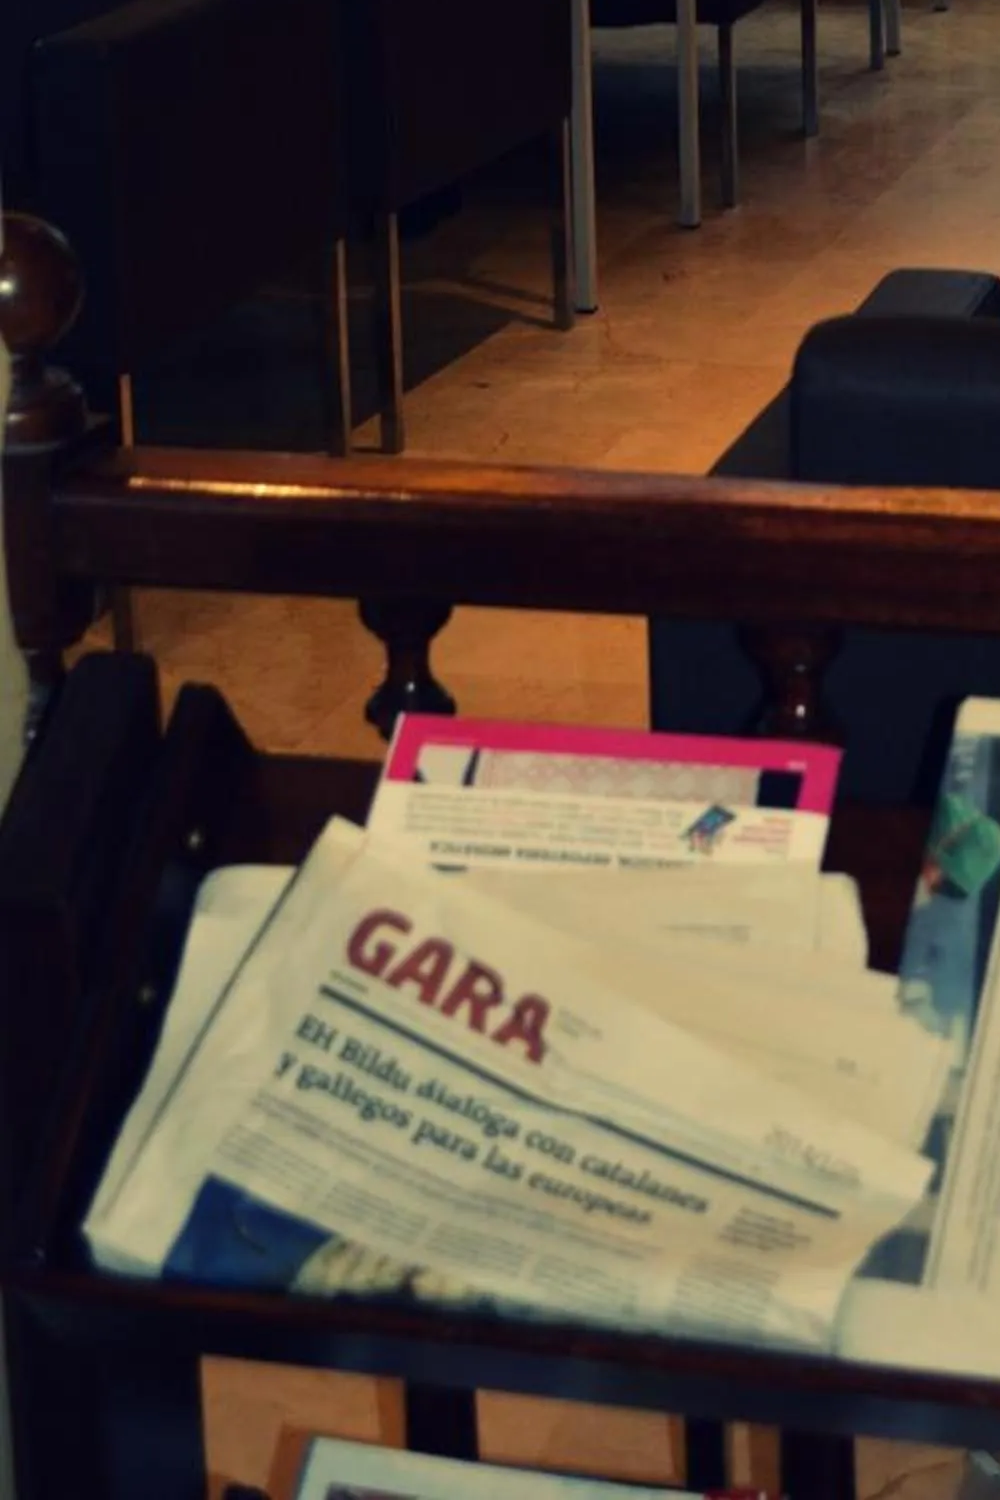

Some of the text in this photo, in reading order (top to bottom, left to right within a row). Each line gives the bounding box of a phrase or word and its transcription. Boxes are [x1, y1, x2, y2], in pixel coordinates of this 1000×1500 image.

[347, 906, 551, 1067] GARA
[273, 1051, 651, 1224] y gallegos para las europeas
[296, 1014, 338, 1050] EH
[337, 1036, 411, 1093] Bildu
[416, 1078, 520, 1139] dialoga
[525, 1129, 577, 1165] con
[580, 1155, 709, 1214] catalanes
